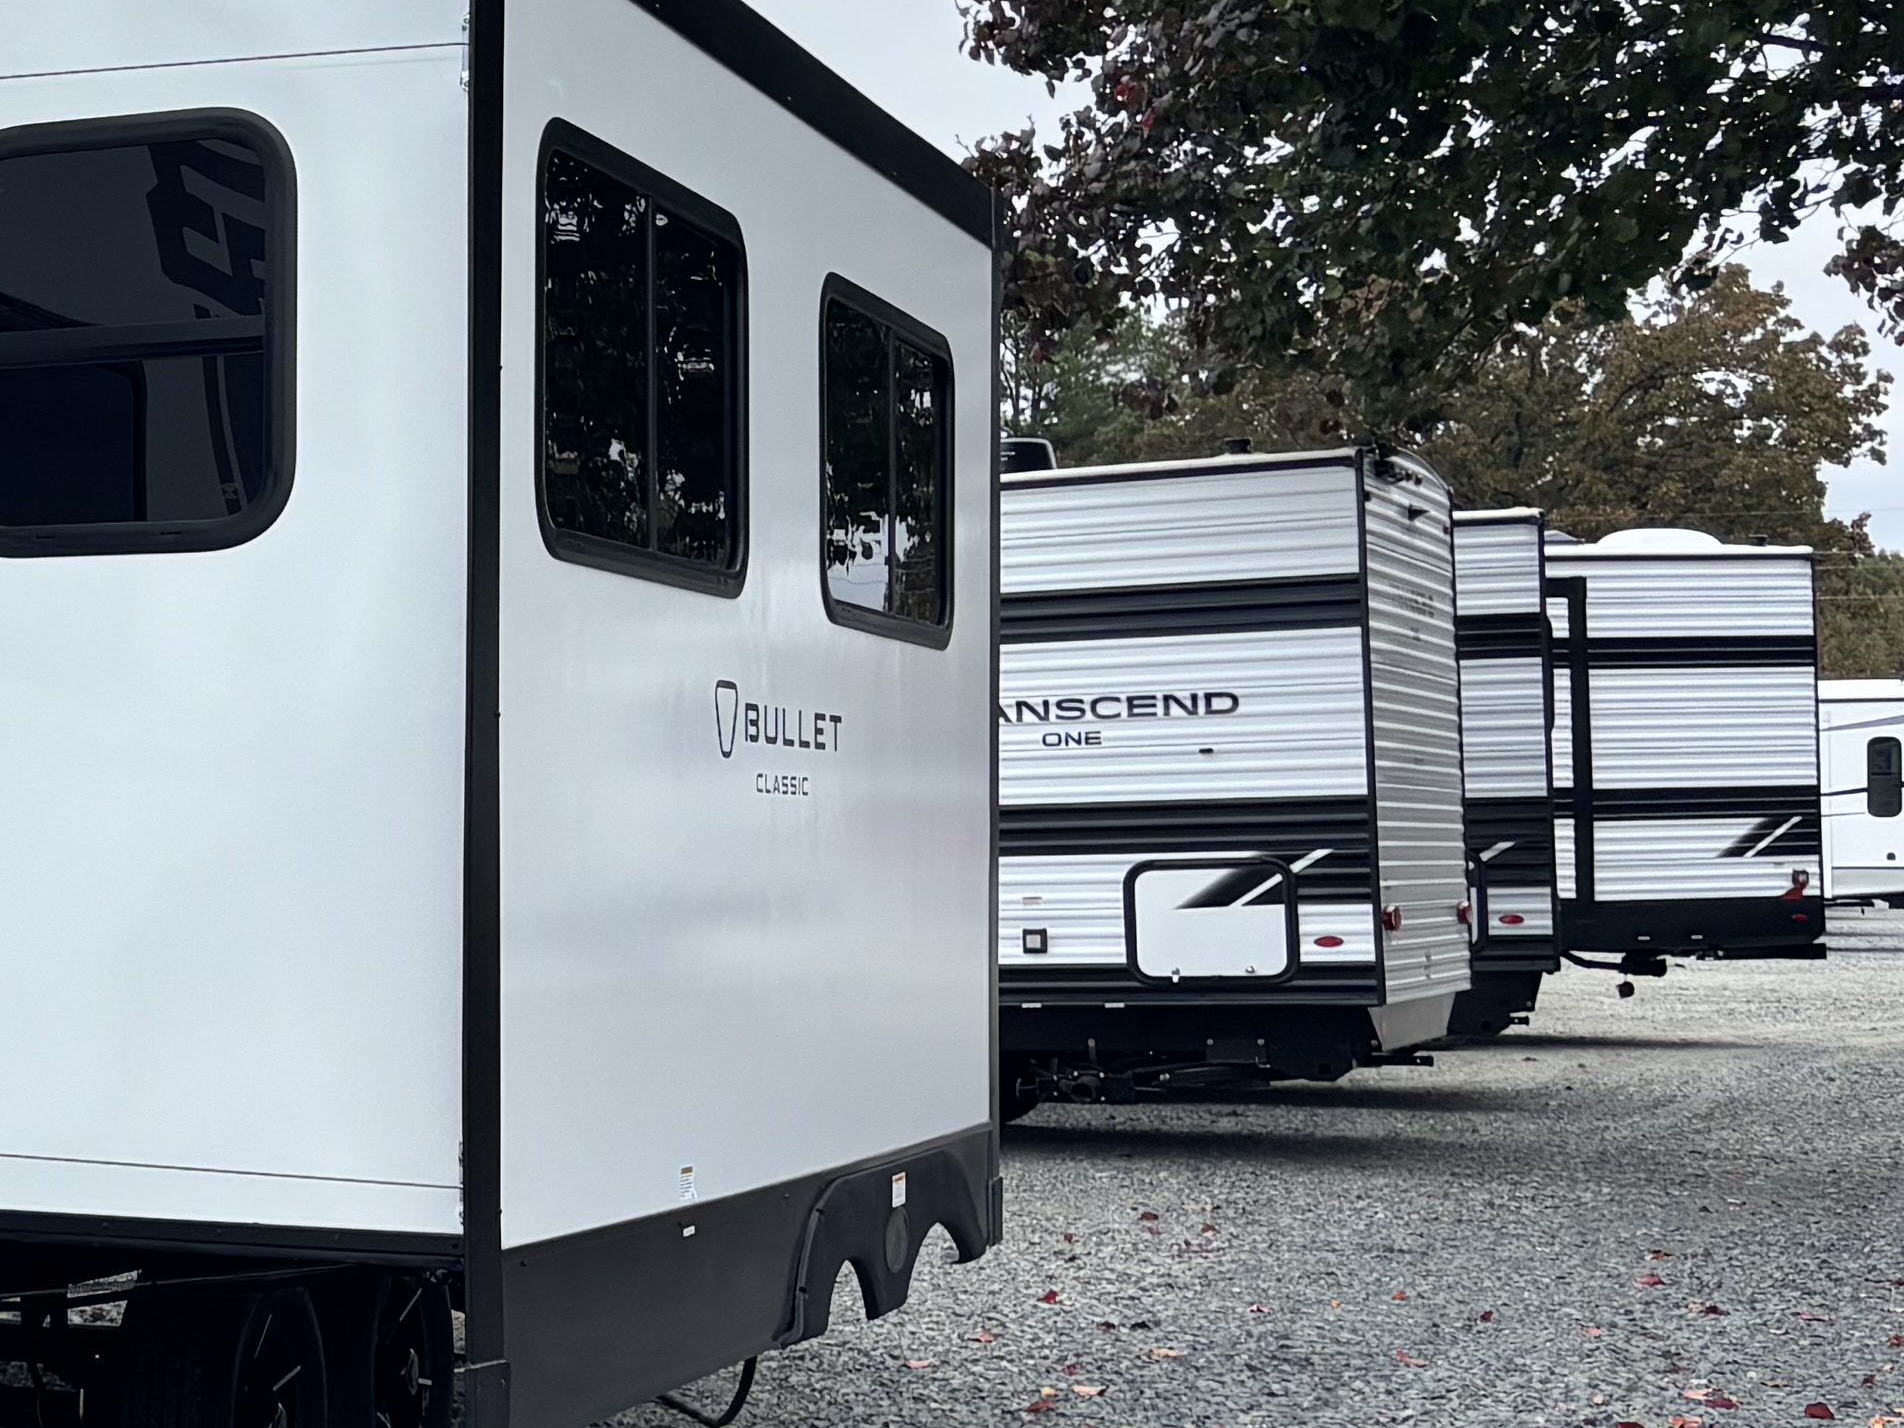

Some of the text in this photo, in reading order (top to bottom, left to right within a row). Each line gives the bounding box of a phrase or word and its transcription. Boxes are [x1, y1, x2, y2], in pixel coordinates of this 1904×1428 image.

[744, 701, 843, 753] BULLET
[1041, 730, 1103, 748] ONE
[755, 772, 810, 797] CLASSIC
